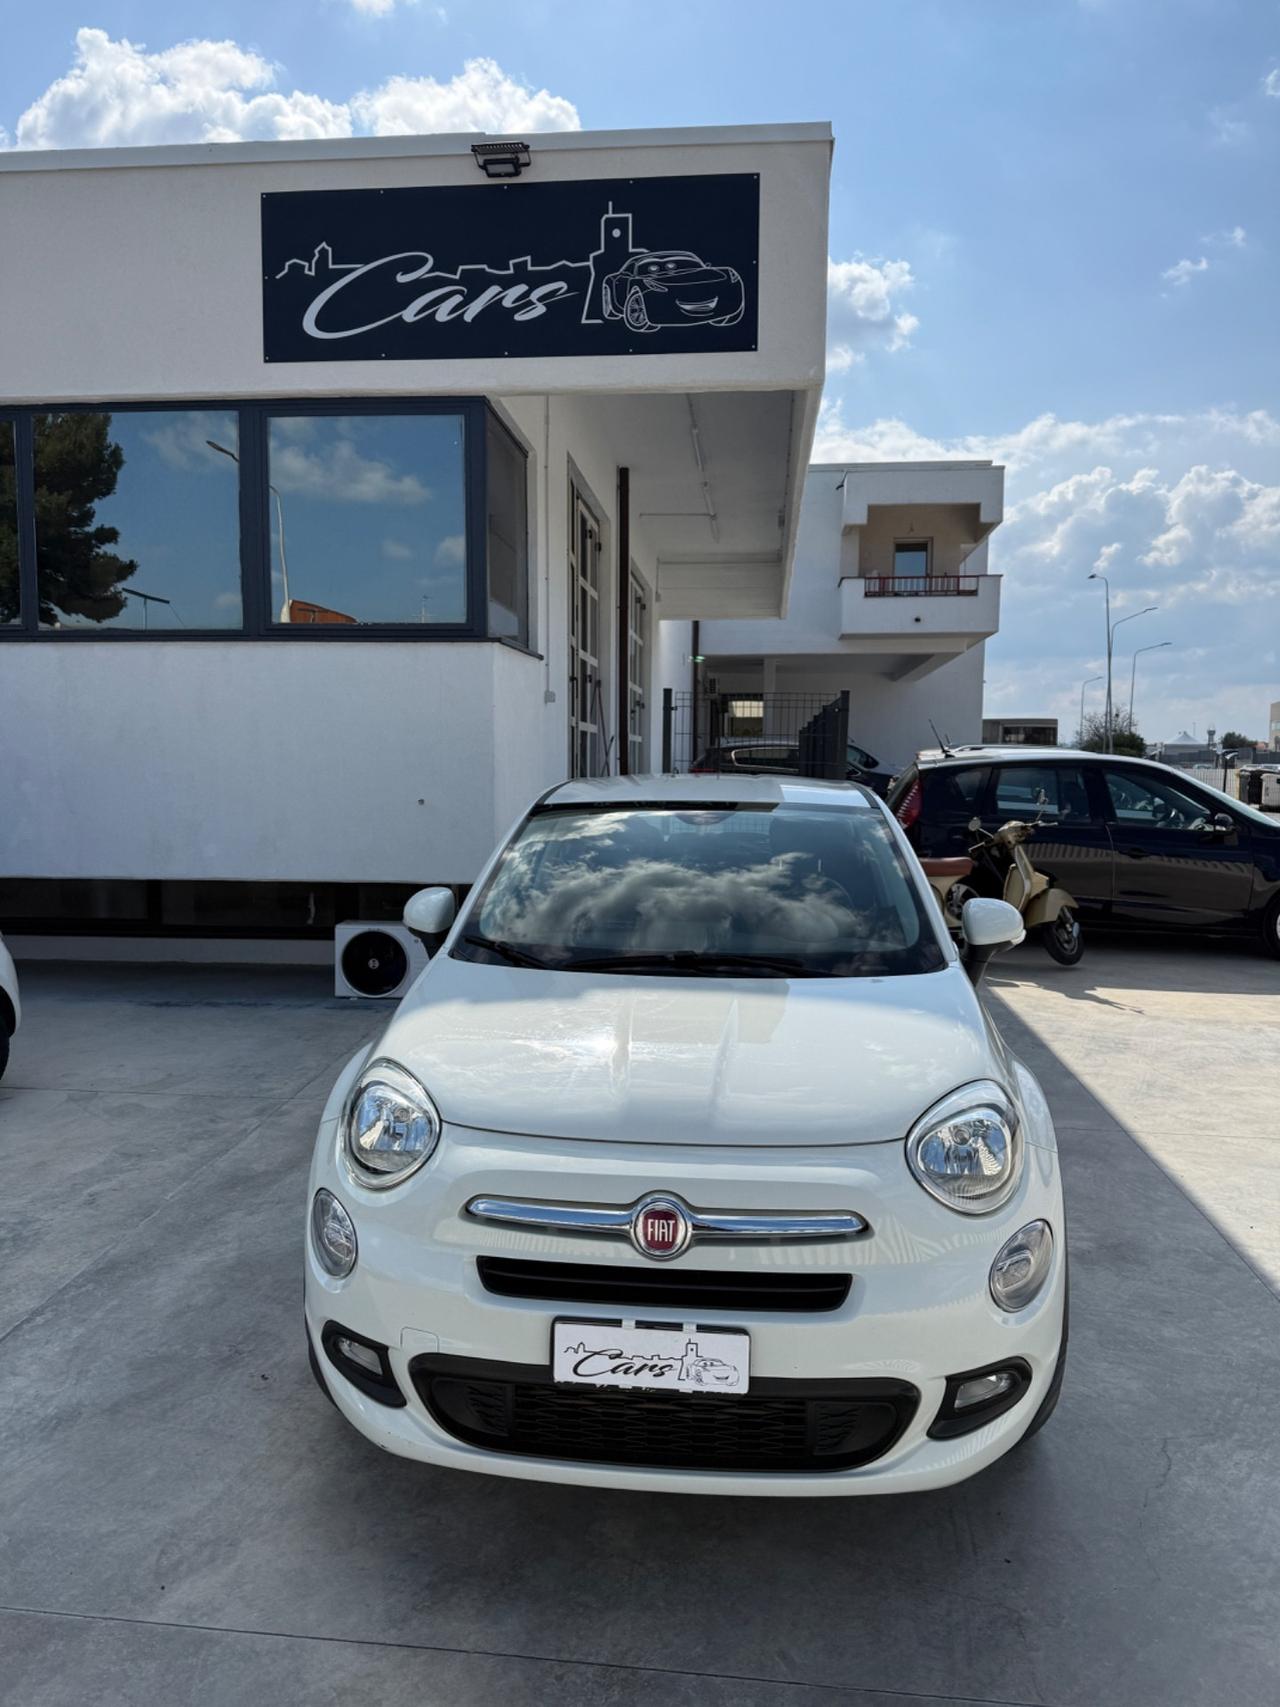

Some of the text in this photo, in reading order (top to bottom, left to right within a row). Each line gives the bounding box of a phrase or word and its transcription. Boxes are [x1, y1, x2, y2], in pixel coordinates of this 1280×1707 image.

[302, 251, 579, 339] Cars
[647, 1218, 676, 1243] FIAT
[572, 1348, 676, 1378] Cars
